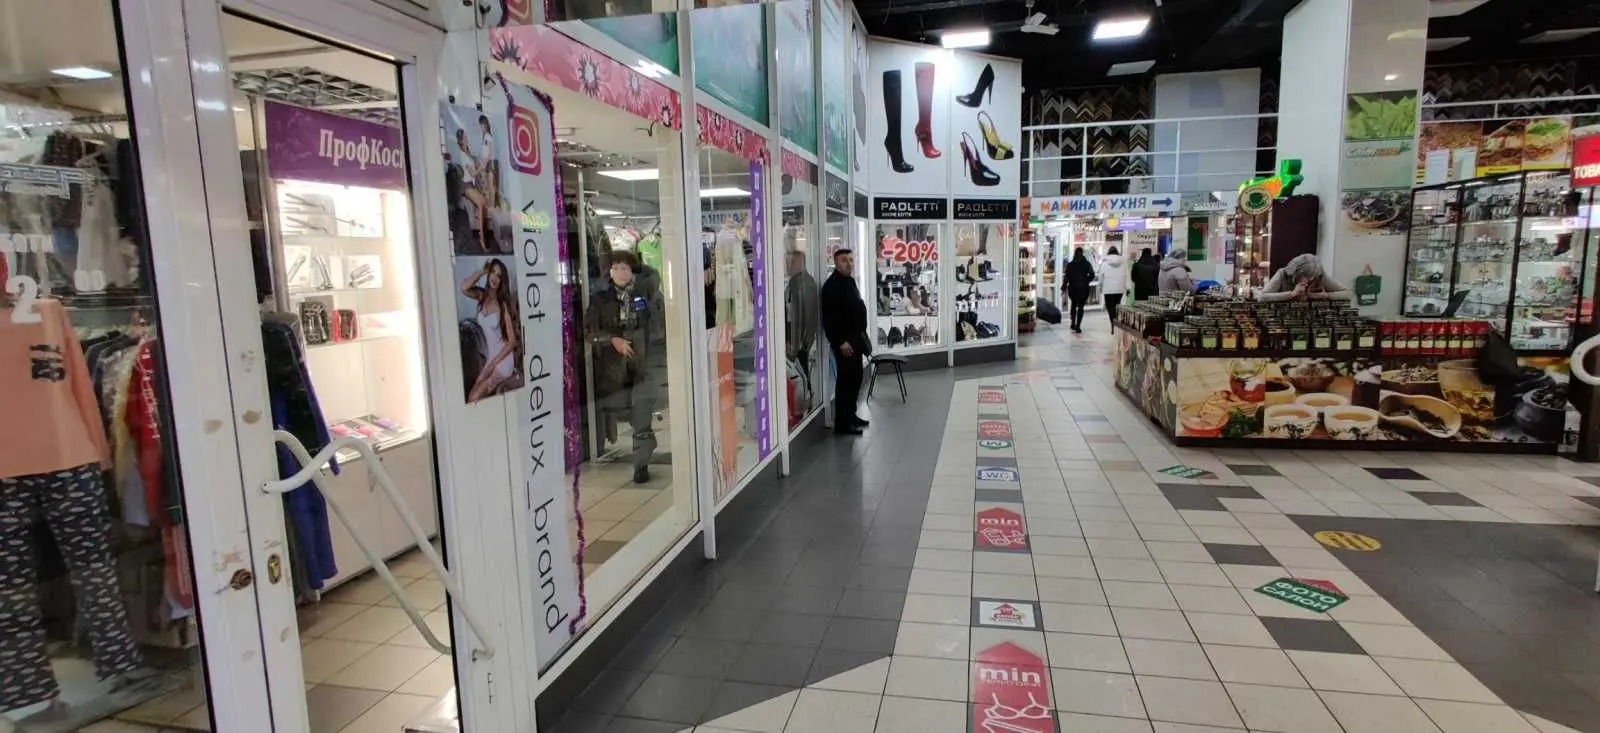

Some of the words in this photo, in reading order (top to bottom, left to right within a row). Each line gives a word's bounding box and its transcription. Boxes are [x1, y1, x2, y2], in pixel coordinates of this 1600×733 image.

[319, 128, 402, 170] ПрофКос
[880, 201, 938, 213] PAOLETTI
[957, 202, 1009, 213] PAOLETTI
[1040, 199, 1096, 212] МАМИНА
[1100, 197, 1147, 211] КУХНЯ
[882, 241, 939, 264] -20%
[980, 516, 1019, 526] min
[1262, 586, 1330, 610] САЛОН
[1275, 581, 1338, 604] ФОТО
[979, 667, 1041, 684] min
